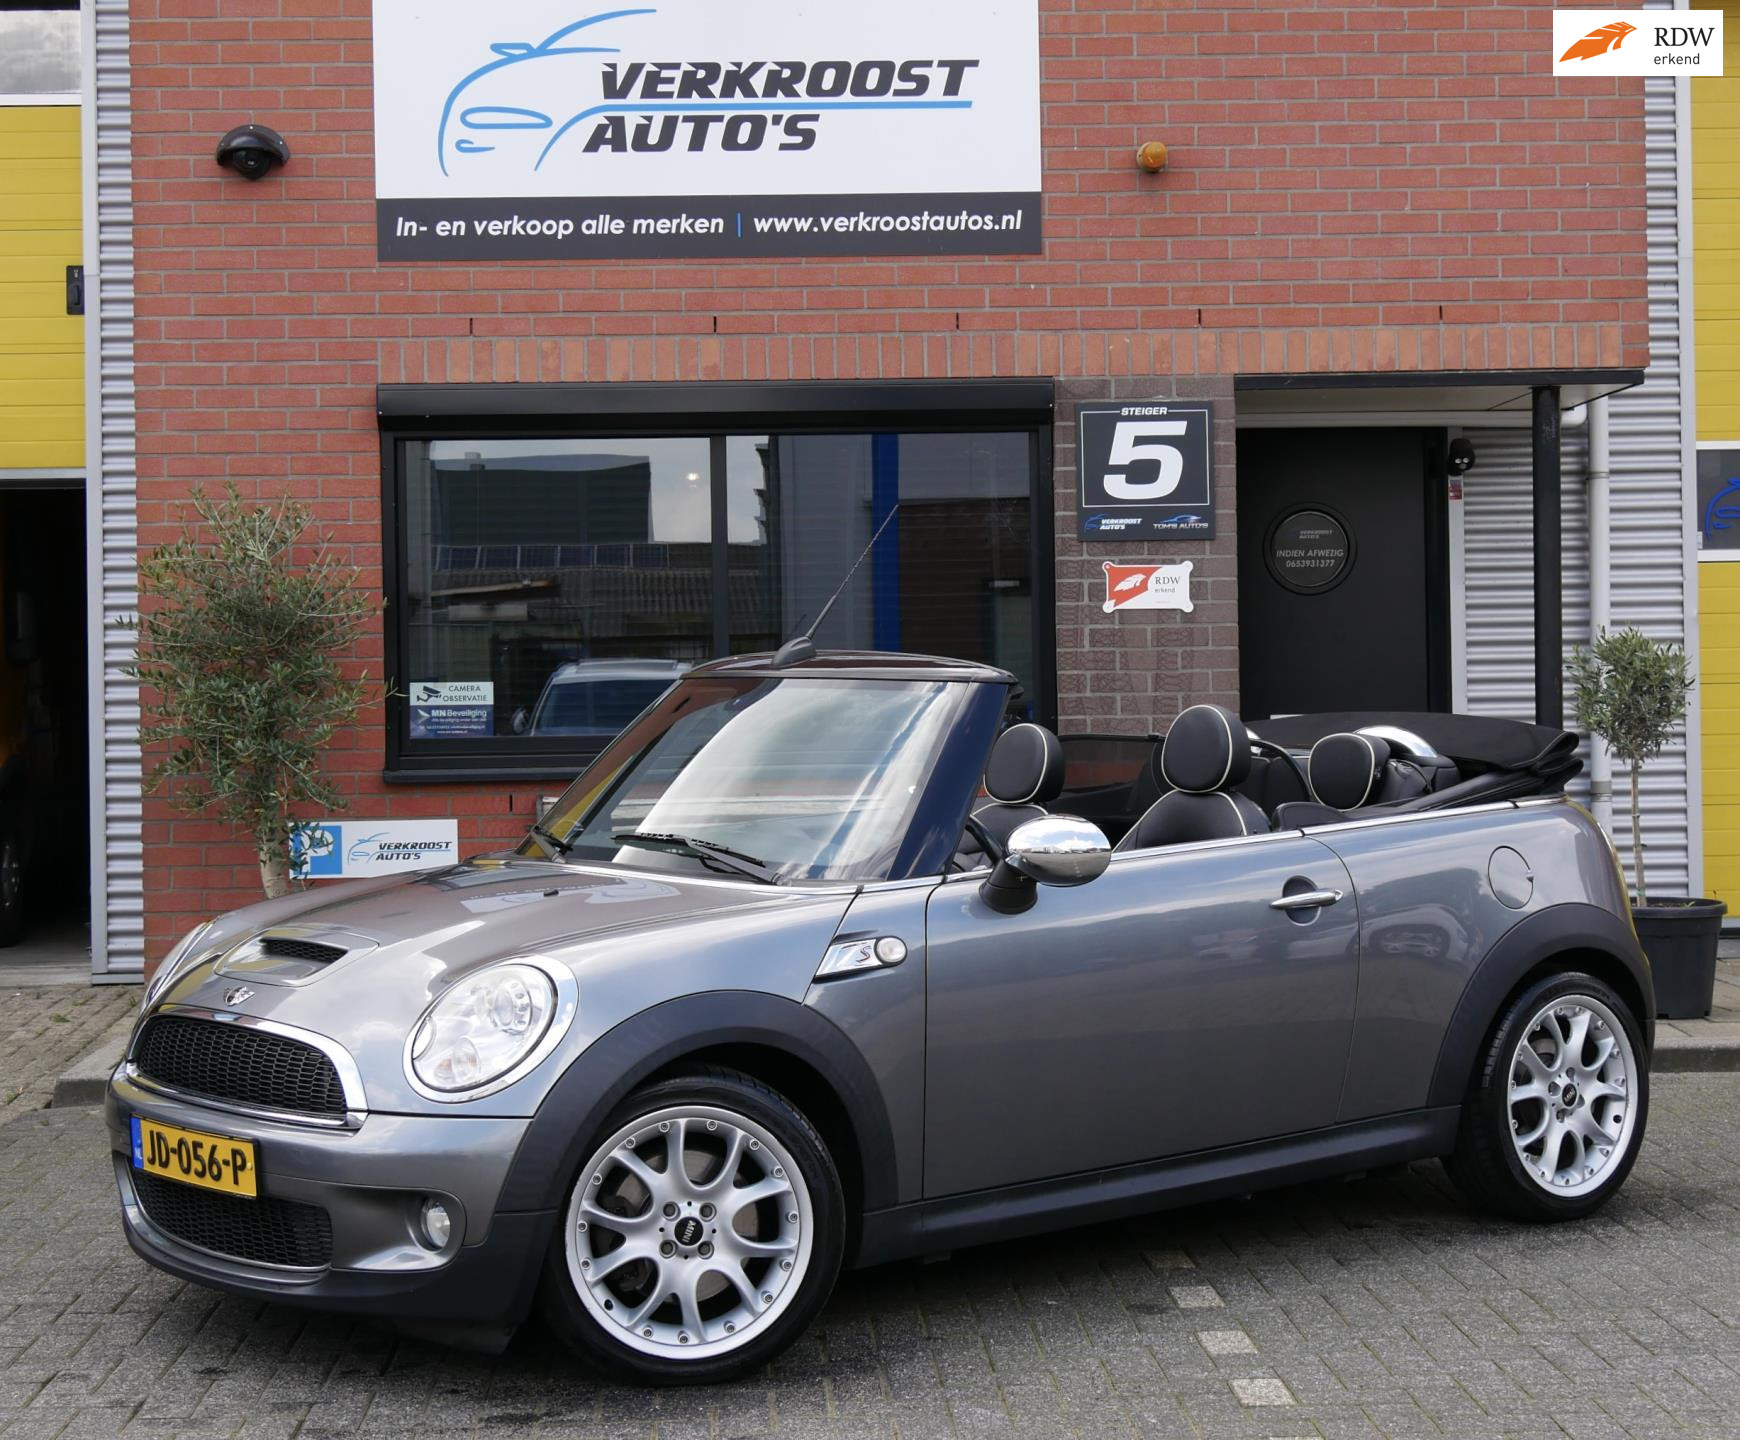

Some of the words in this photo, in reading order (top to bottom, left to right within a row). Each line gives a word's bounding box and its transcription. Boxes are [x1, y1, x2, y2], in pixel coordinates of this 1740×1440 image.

[601, 59, 980, 100] VERKROOST
[582, 114, 820, 153] AUTO'S
[396, 216, 428, 237] In-
[435, 220, 466, 237] en
[474, 214, 574, 240] verkoop
[581, 214, 626, 235] alle
[632, 213, 724, 236] merken
[753, 209, 1023, 234] www.verkroostautos.nl
[1121, 407, 1168, 416] STEIGER
[1103, 421, 1188, 500] 5
[1276, 549, 1305, 557] INDIEN
[1307, 549, 1344, 557] AFWEZIG
[1155, 576, 1181, 585] RDW
[442, 694, 488, 702] OBSERVATIE
[447, 709, 487, 718] Beveiliging
[379, 842, 452, 851] VERKROOST
[376, 852, 422, 861] AUTO'S
[147, 1130, 247, 1186] JD-056-P
